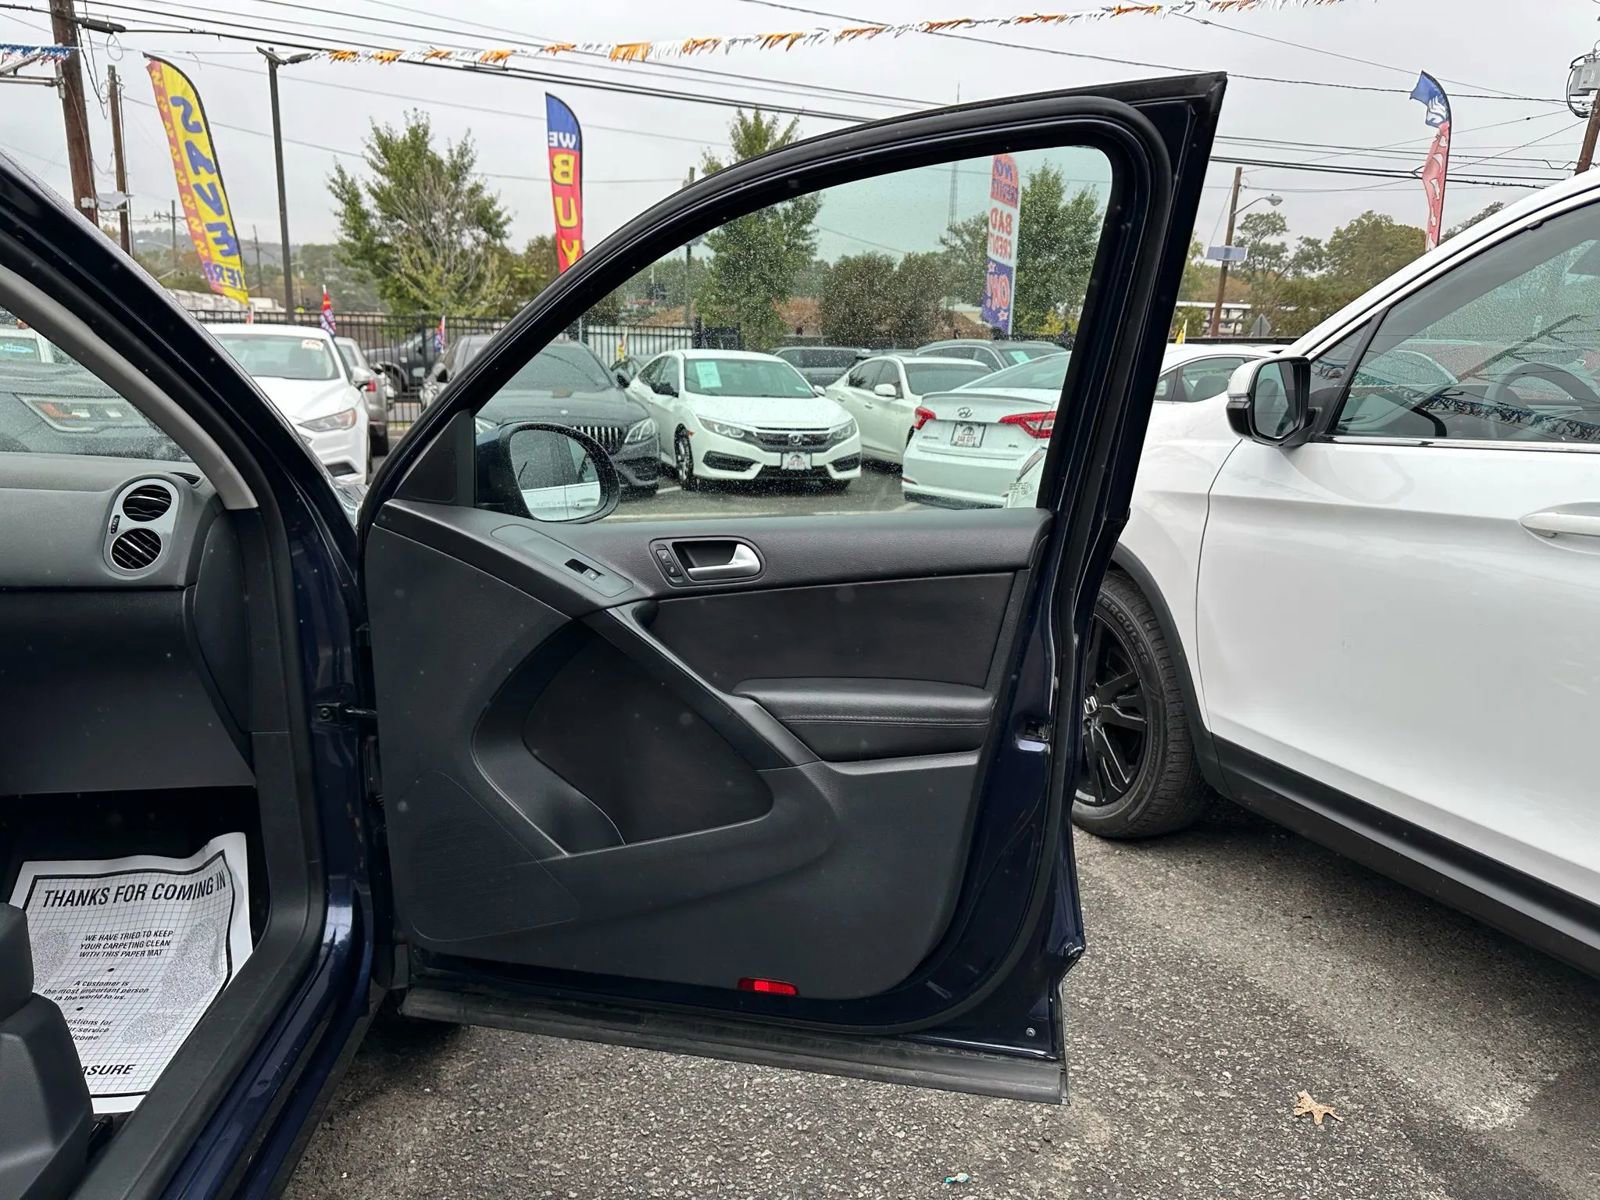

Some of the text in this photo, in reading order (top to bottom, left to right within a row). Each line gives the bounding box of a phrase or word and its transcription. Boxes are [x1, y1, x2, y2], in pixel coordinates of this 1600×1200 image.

[43, 870, 226, 908] THANKS FOR COMING IN
[85, 929, 174, 942] WE HAVE TRIED TO KEEP
[80, 939, 171, 950] YOUR CARPETING CLEAN
[102, 950, 120, 958] THIS
[120, 950, 146, 958] PAPER
[147, 949, 164, 957] MAT
[119, 988, 150, 996] person
[66, 1018, 98, 1026] estions
